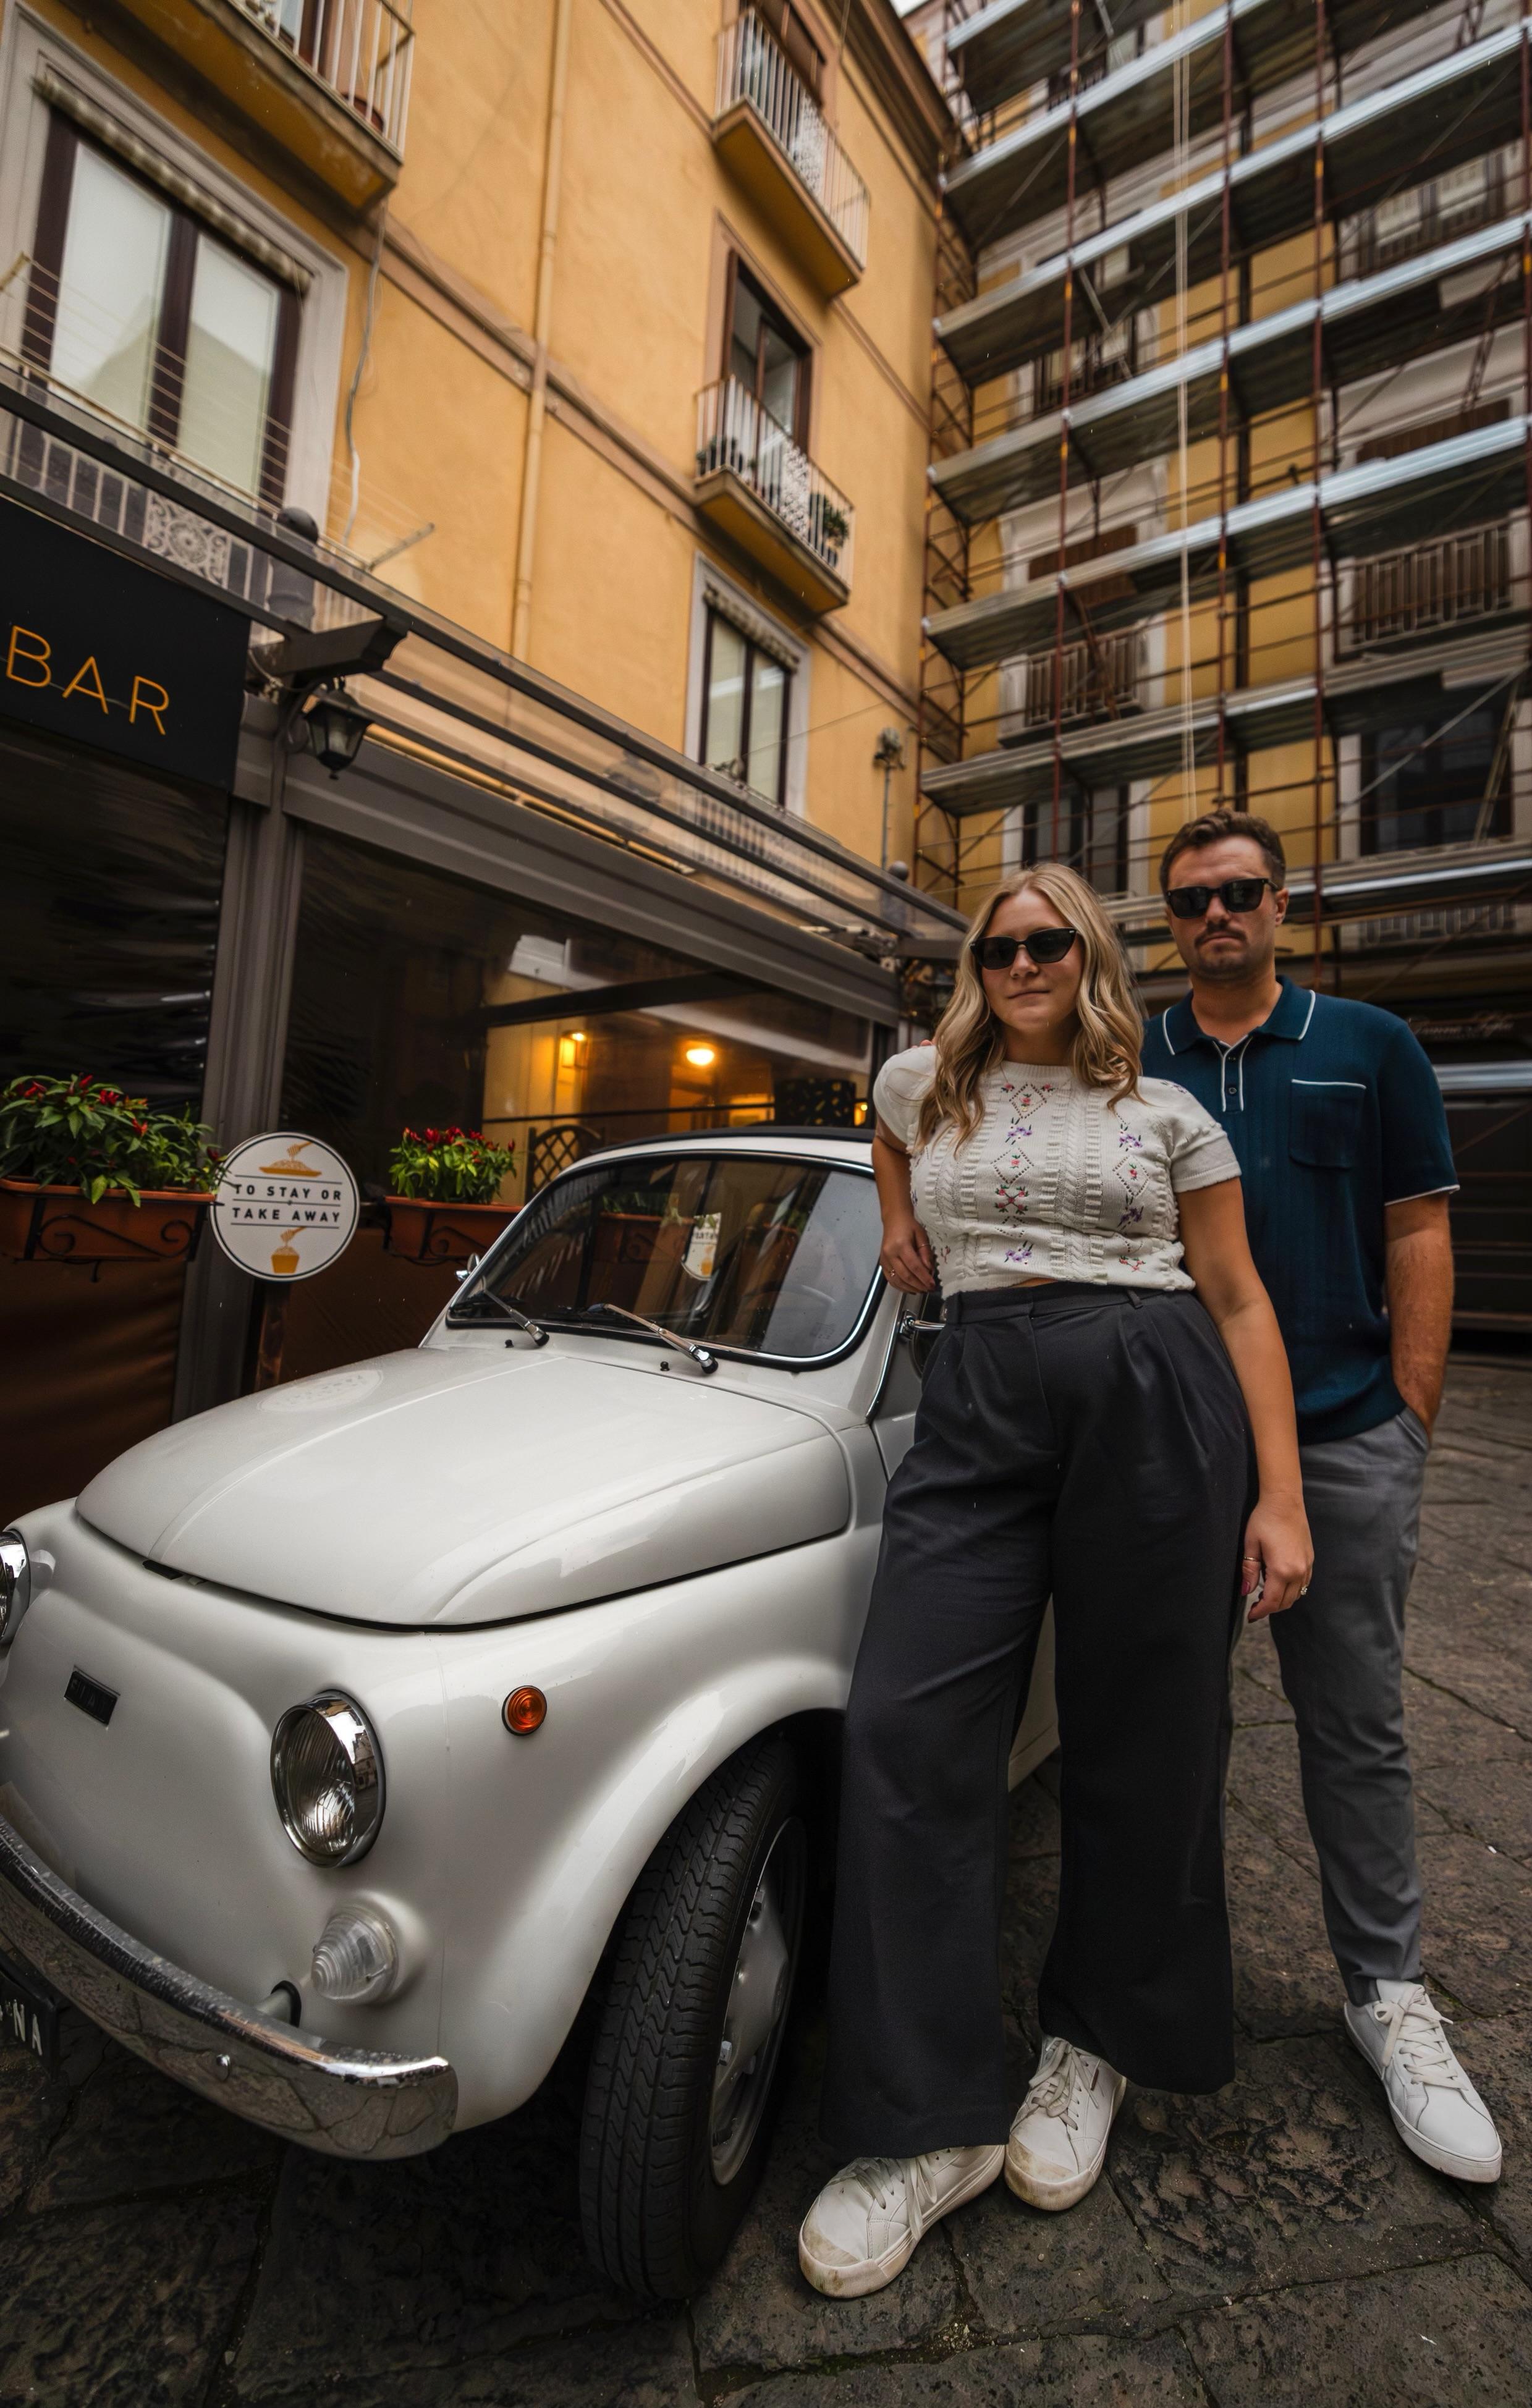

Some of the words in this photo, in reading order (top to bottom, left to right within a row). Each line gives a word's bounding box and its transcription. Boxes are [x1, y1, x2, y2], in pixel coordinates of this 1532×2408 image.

[6, 625, 169, 735] BAR
[235, 1184, 255, 1195] TO
[267, 1186, 310, 1199] STAY
[321, 1189, 341, 1201] OR
[232, 1207, 280, 1220] TAKE
[292, 1210, 339, 1222] AWAY
